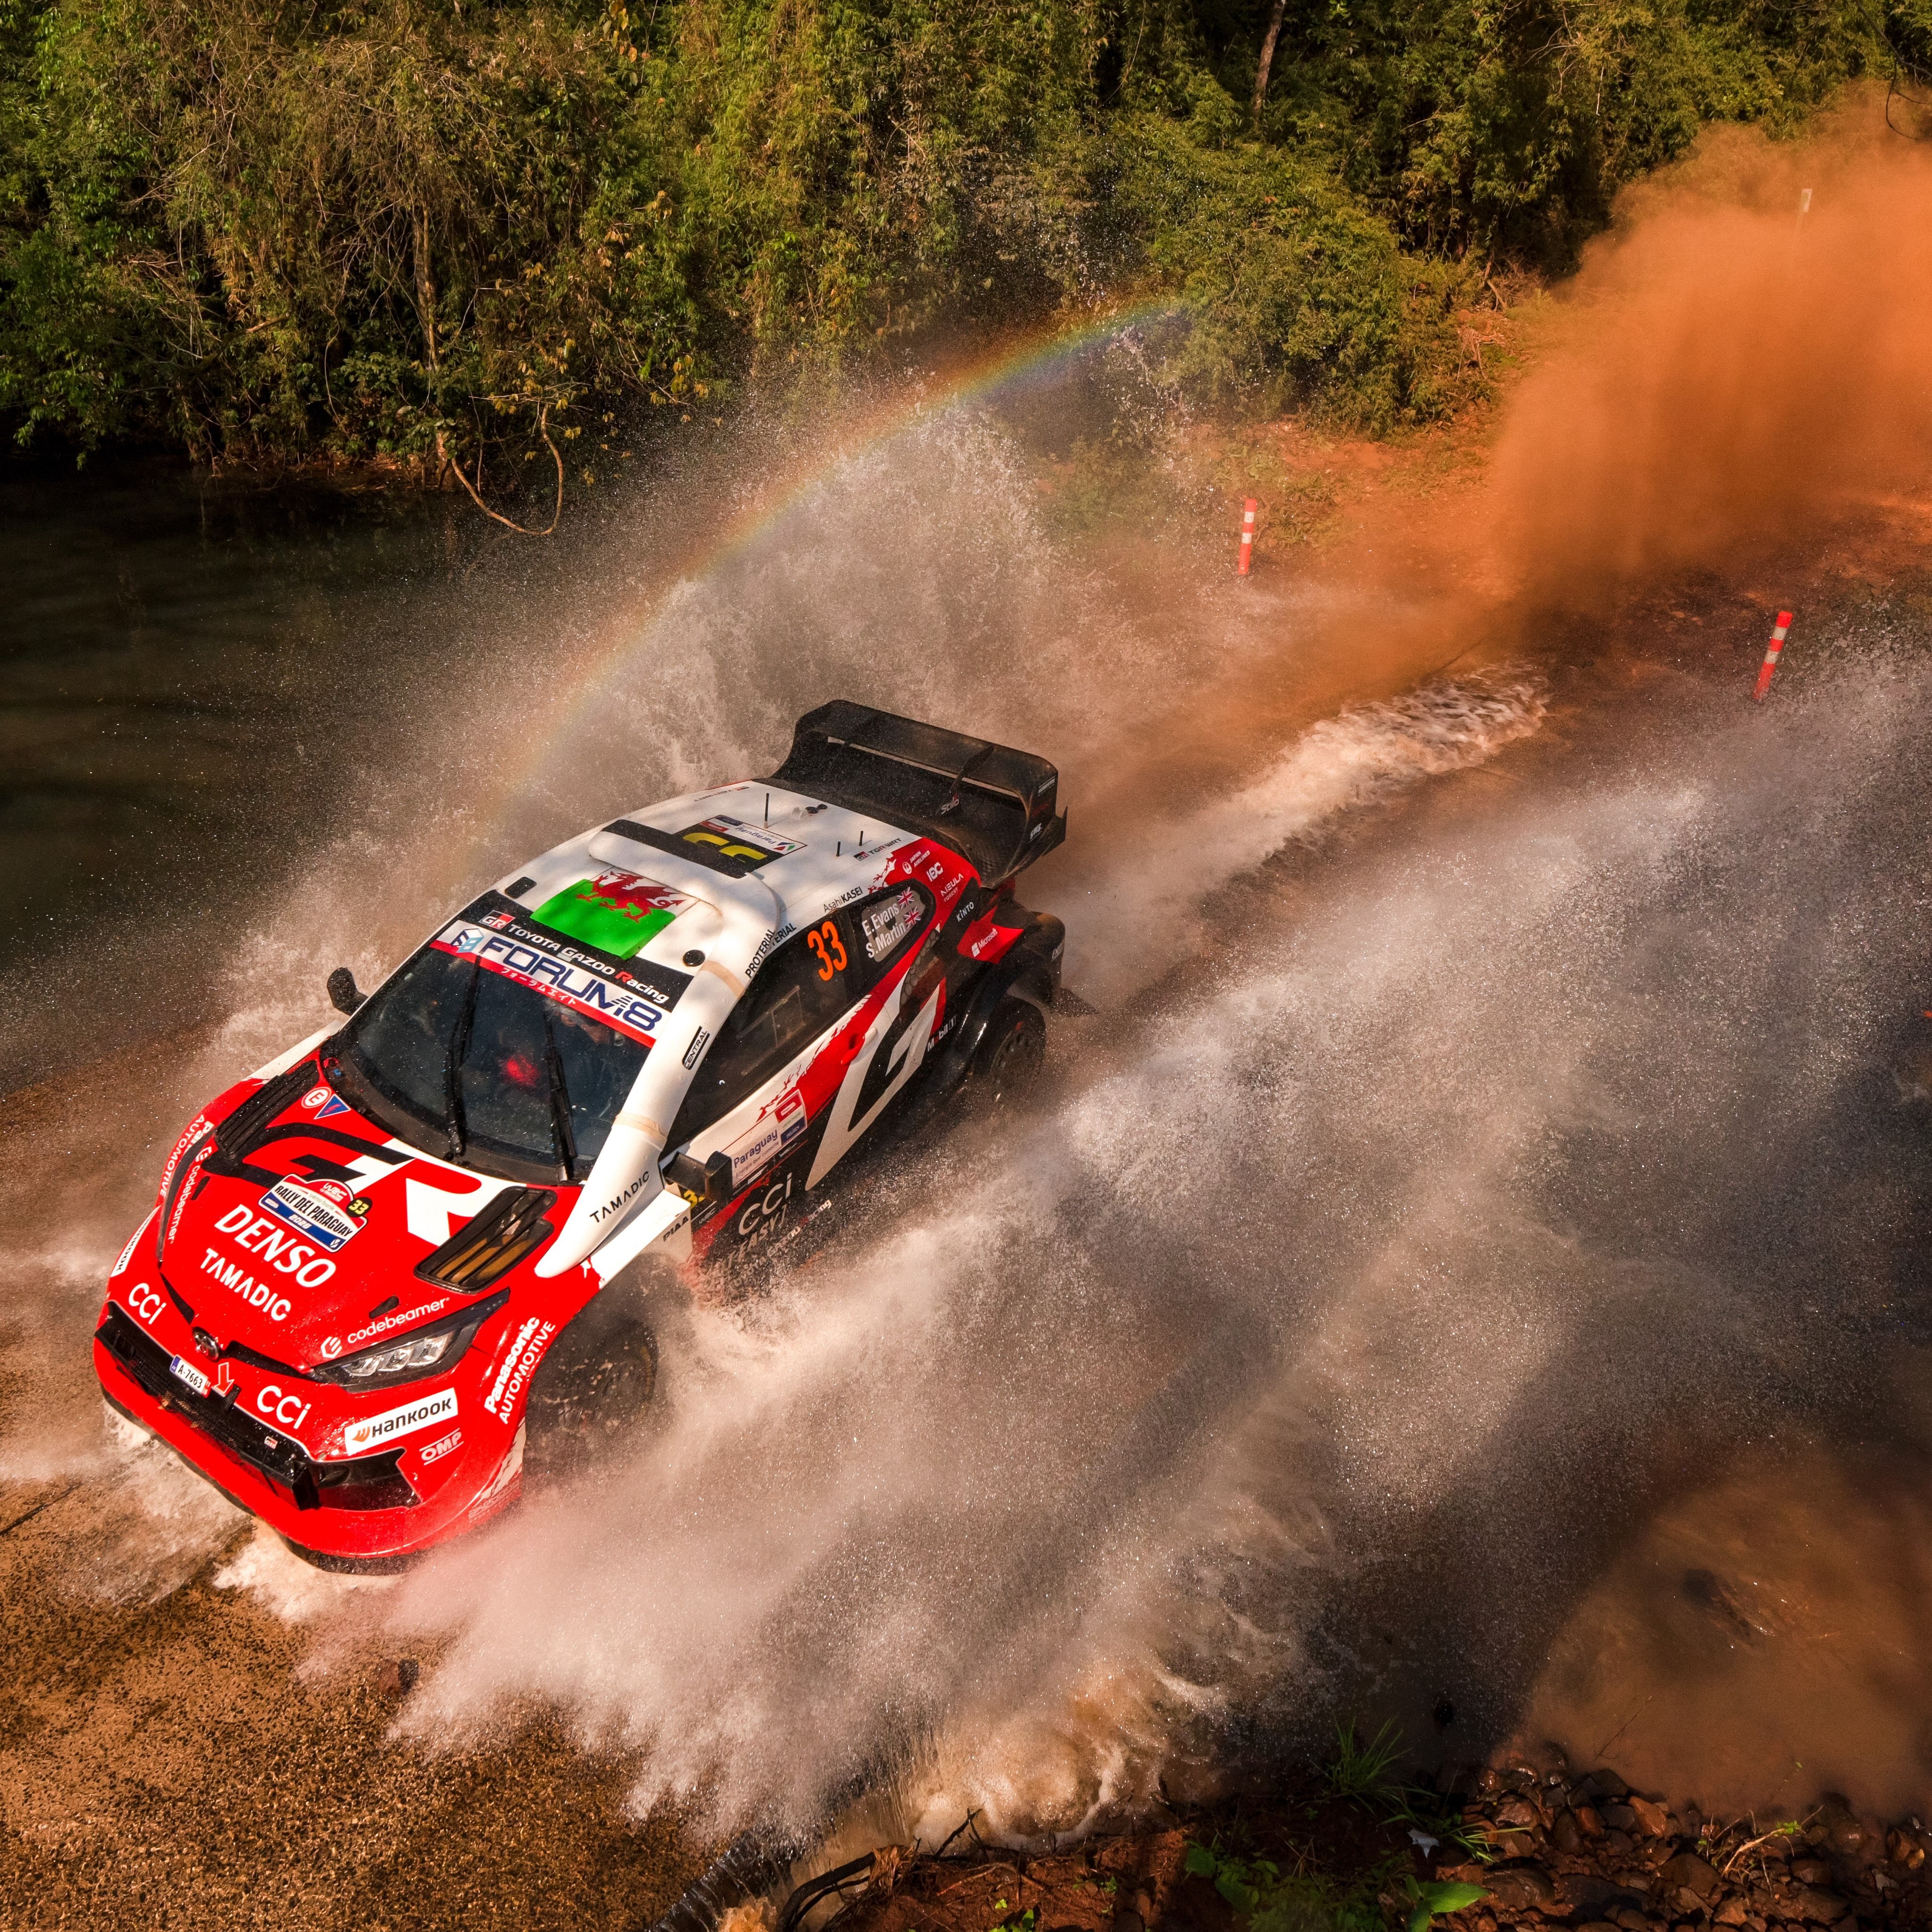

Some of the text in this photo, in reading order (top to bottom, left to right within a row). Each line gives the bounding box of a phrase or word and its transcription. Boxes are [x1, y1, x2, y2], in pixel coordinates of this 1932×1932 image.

[941, 795, 959, 815] Stilo
[735, 826, 777, 845] Paraguay
[868, 838, 902, 855] TGR-WRT
[910, 850, 922, 864] JAPAN
[914, 850, 931, 868] AIRLINES
[744, 929, 775, 979] PROTERIAL
[772, 923, 797, 946] ERIAL
[807, 921, 848, 982] 33
[978, 927, 998, 949] Microsoft
[479, 935, 663, 1032] FORUM8
[508, 924, 561, 951] TOYOTA
[561, 947, 616, 976] GAZOO
[615, 971, 670, 1005] Racing
[500, 966, 577, 1006] フォーラムエイト
[684, 1030, 708, 1069] CENTRAL
[927, 1023, 949, 1052] Mobil
[308, 1091, 325, 1104] E
[160, 1115, 205, 1198] AUTOMOTIVE
[733, 1129, 778, 1169] Paraguay
[167, 1165, 200, 1244] codebeamer
[323, 1182, 348, 1199] WRC
[349, 1199, 369, 1215] 33
[589, 1170, 651, 1224] TAMADIC
[275, 1185, 301, 1206] RALLY
[293, 1197, 312, 1214] DEL
[307, 1205, 353, 1237] PARAGUAY
[662, 1216, 689, 1242] PIAA
[214, 1203, 337, 1288] DENSO
[200, 1248, 291, 1321] TAMADIC
[347, 1298, 450, 1343] codebeamer
[177, 1364, 203, 1389] A-7663
[484, 1316, 540, 1414] Panasonic
[499, 1321, 556, 1424] AUTOMOTIVE
[421, 1431, 462, 1461] OMP
